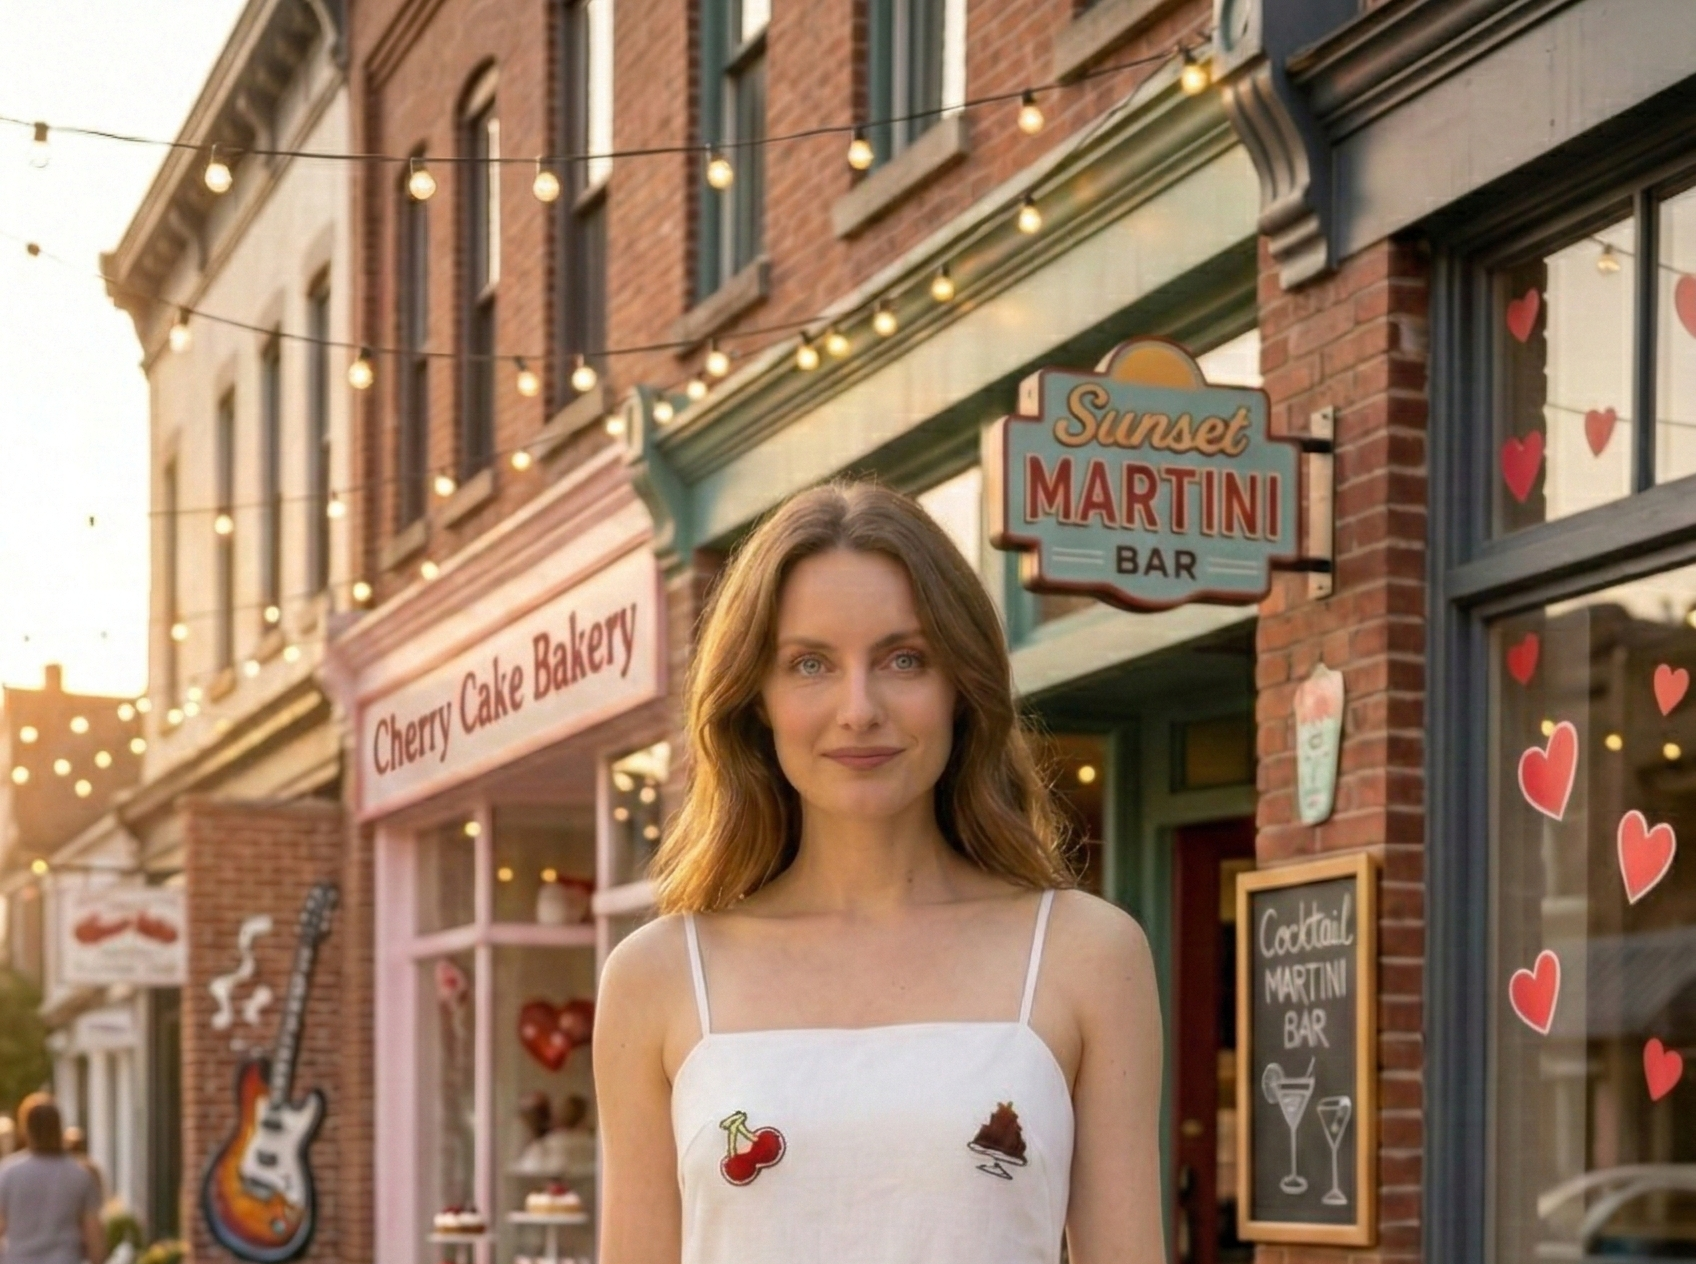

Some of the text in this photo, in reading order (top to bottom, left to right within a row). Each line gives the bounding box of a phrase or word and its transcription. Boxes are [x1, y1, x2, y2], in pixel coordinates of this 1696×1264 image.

[1053, 382, 1249, 456] Sunset
[1025, 453, 1281, 541] MARTINI
[1115, 545, 1197, 580] BAR
[373, 602, 637, 775] Cherry Cake Bakery
[1259, 893, 1354, 958] Cocktail
[1264, 957, 1347, 1005] MARTINI
[1284, 1008, 1329, 1049] BAR
